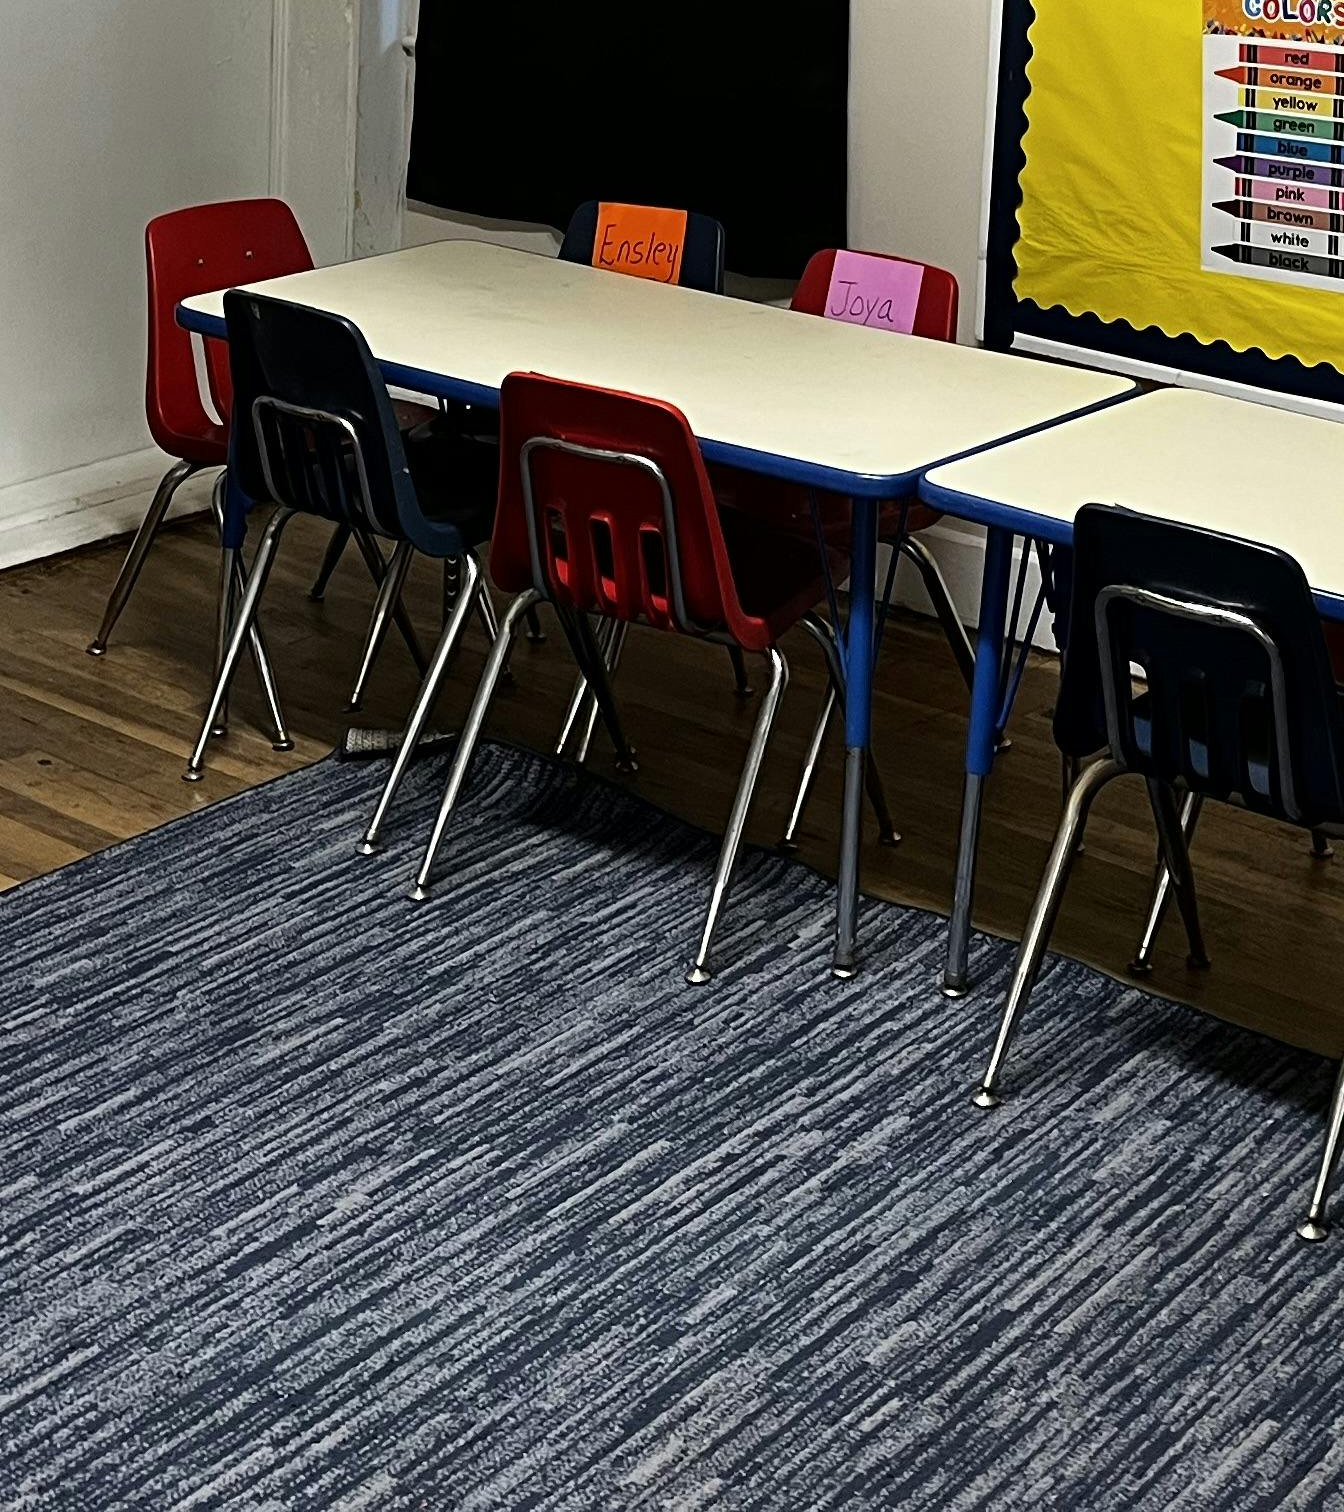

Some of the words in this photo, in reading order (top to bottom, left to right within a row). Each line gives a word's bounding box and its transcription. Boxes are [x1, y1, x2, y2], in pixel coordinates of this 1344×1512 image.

[1285, 52, 1309, 65] red
[1270, 73, 1321, 90] orange
[1273, 95, 1317, 112] yellow
[1273, 119, 1314, 133] green
[1278, 141, 1308, 157] blue
[1268, 164, 1314, 180] purple
[1276, 186, 1304, 202] pink
[1267, 207, 1313, 225] brown
[1271, 231, 1309, 248] white
[599, 224, 679, 283] Ensley
[1269, 252, 1310, 271] black
[831, 281, 894, 325] Joya
